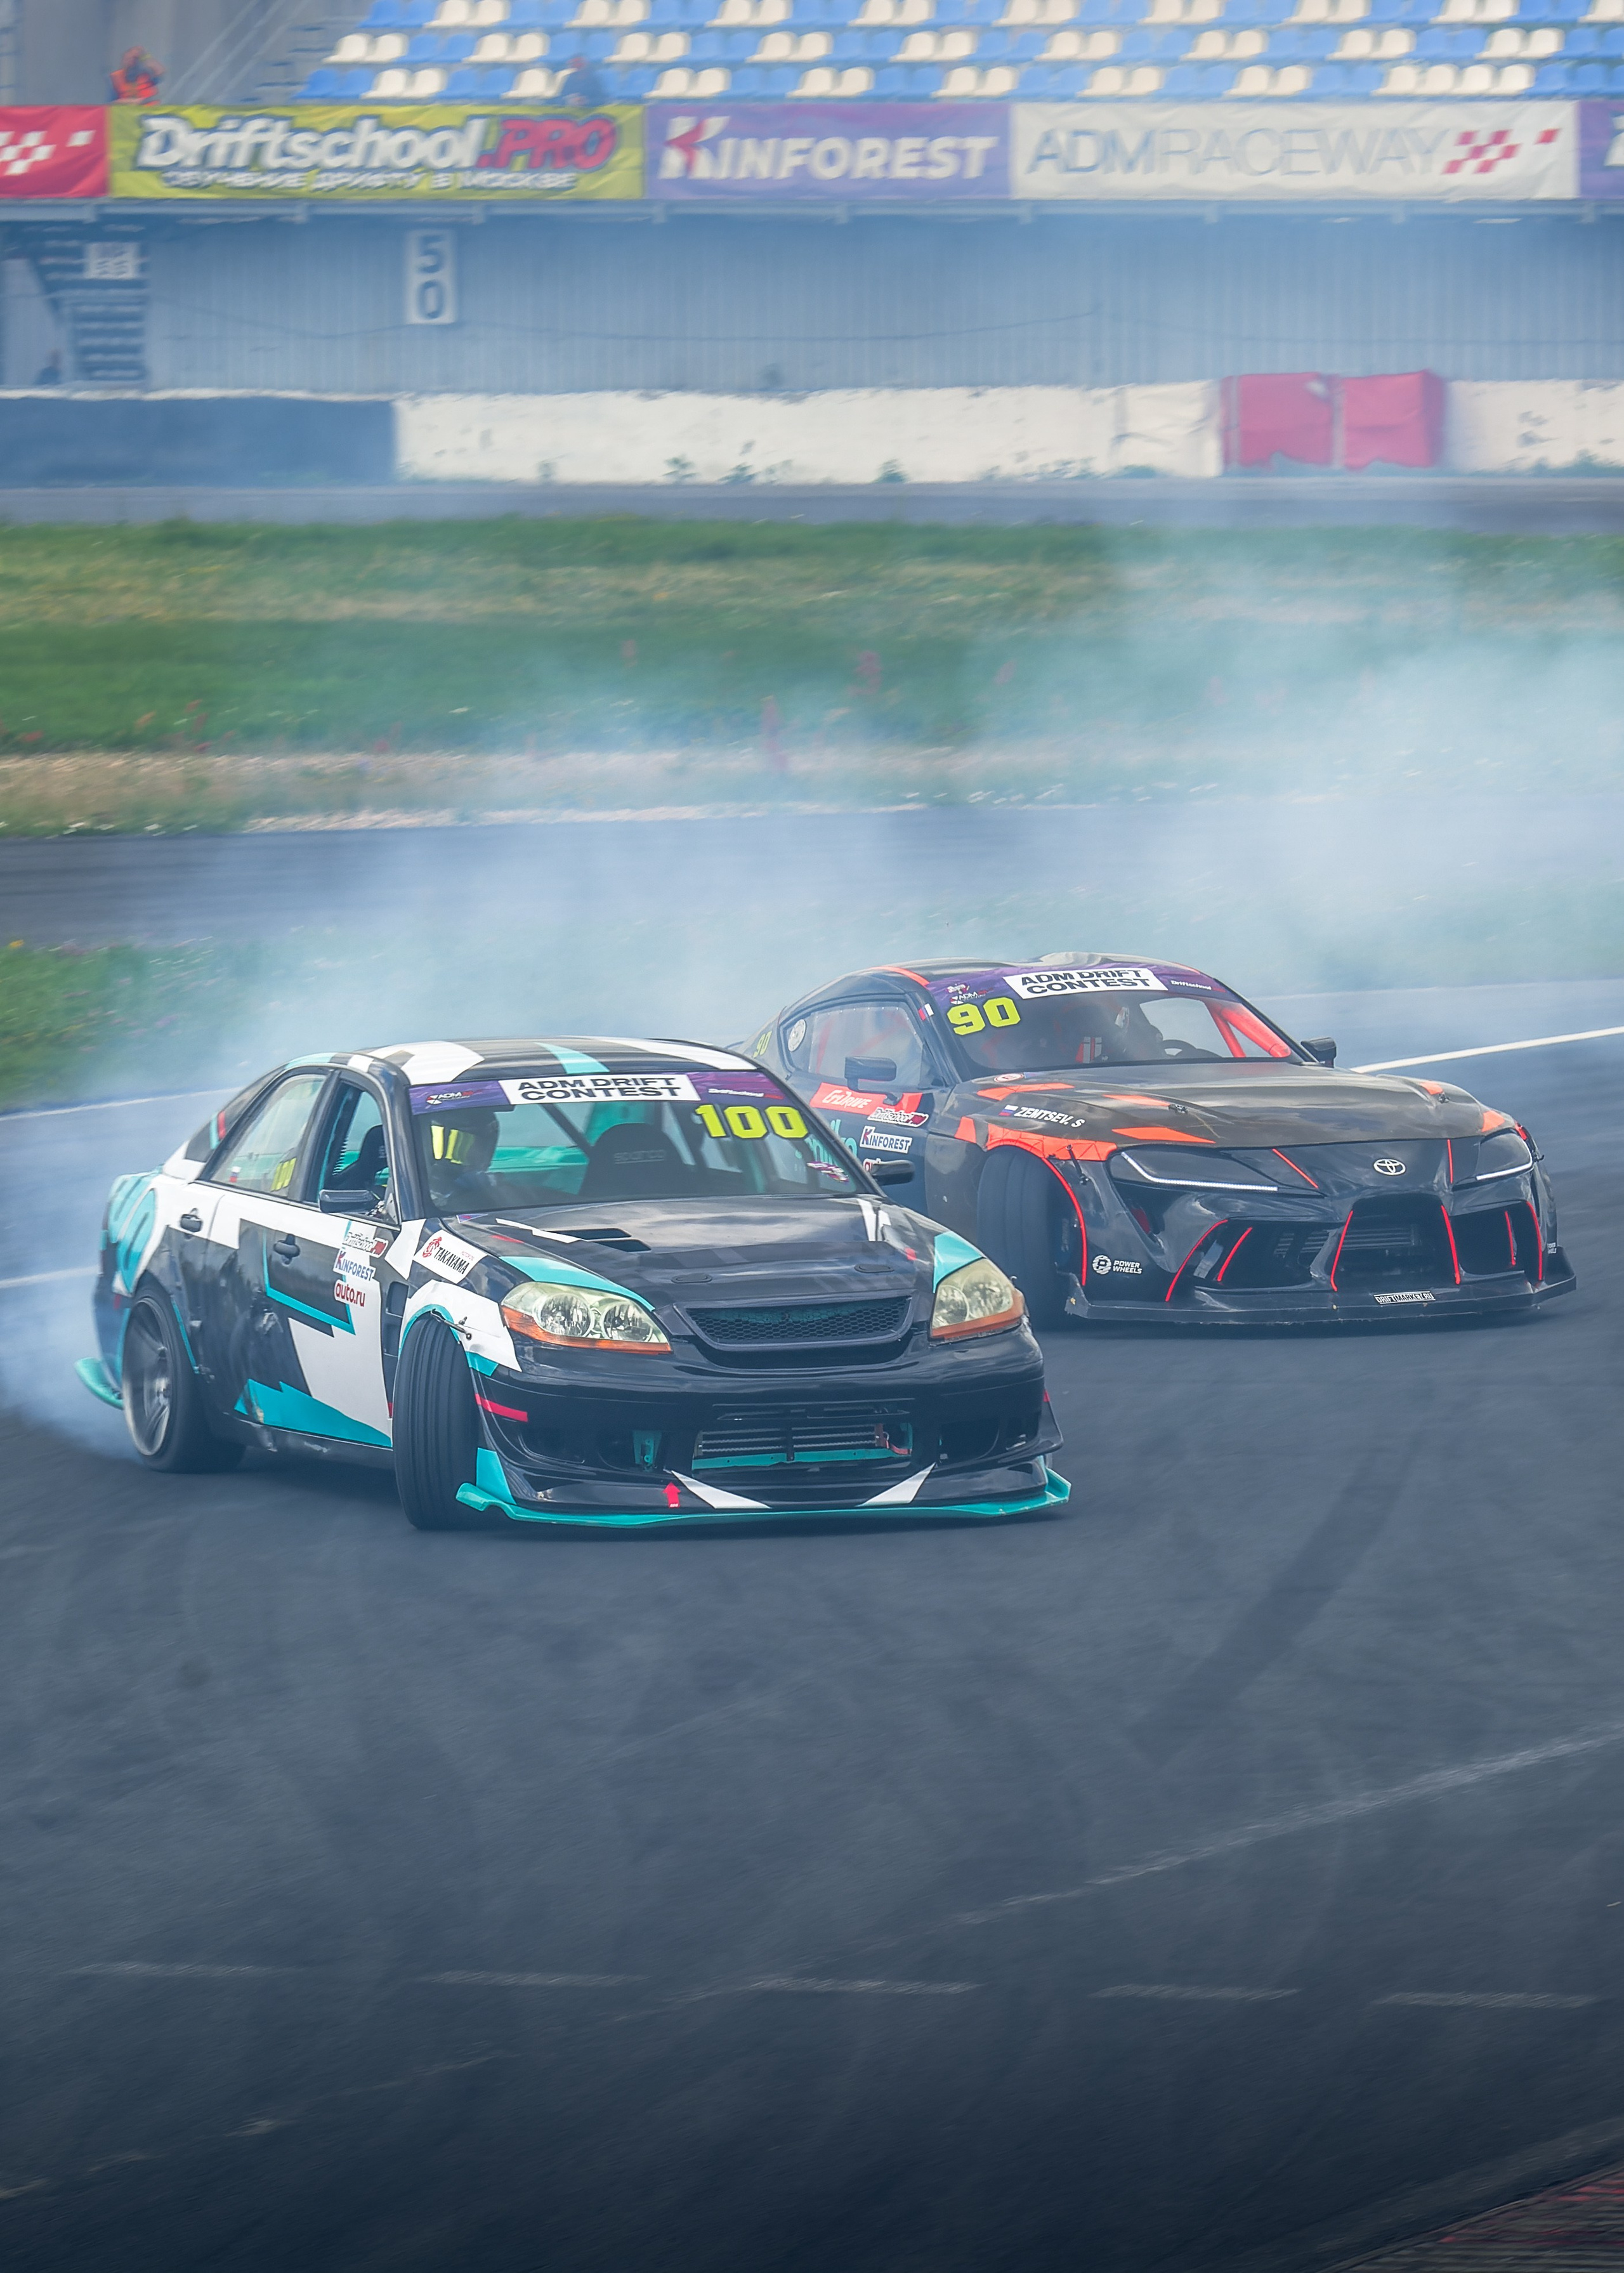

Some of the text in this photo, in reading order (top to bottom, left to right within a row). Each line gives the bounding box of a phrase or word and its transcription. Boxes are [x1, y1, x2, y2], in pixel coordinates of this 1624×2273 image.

[658, 115, 1000, 180] KINFOREST
[1021, 969, 1141, 985] ADM DRIFT
[1026, 978, 1151, 994] CONTEST
[946, 997, 1021, 1035] 90
[752, 1031, 772, 1058] 90
[518, 1078, 676, 1090] ADM DRIFT
[521, 1087, 681, 1100] CONTEST
[695, 1104, 809, 1138] 100
[1071, 1118, 1085, 1128] S
[861, 1129, 910, 1150] KINFOREST
[335, 1251, 374, 1281] KINFOREST
[433, 1247, 470, 1274] TAKAYAMA
[1112, 1266, 1143, 1274] WHEELS
[1113, 1260, 1141, 1269] POWER
[336, 1283, 366, 1307] auto.ru
